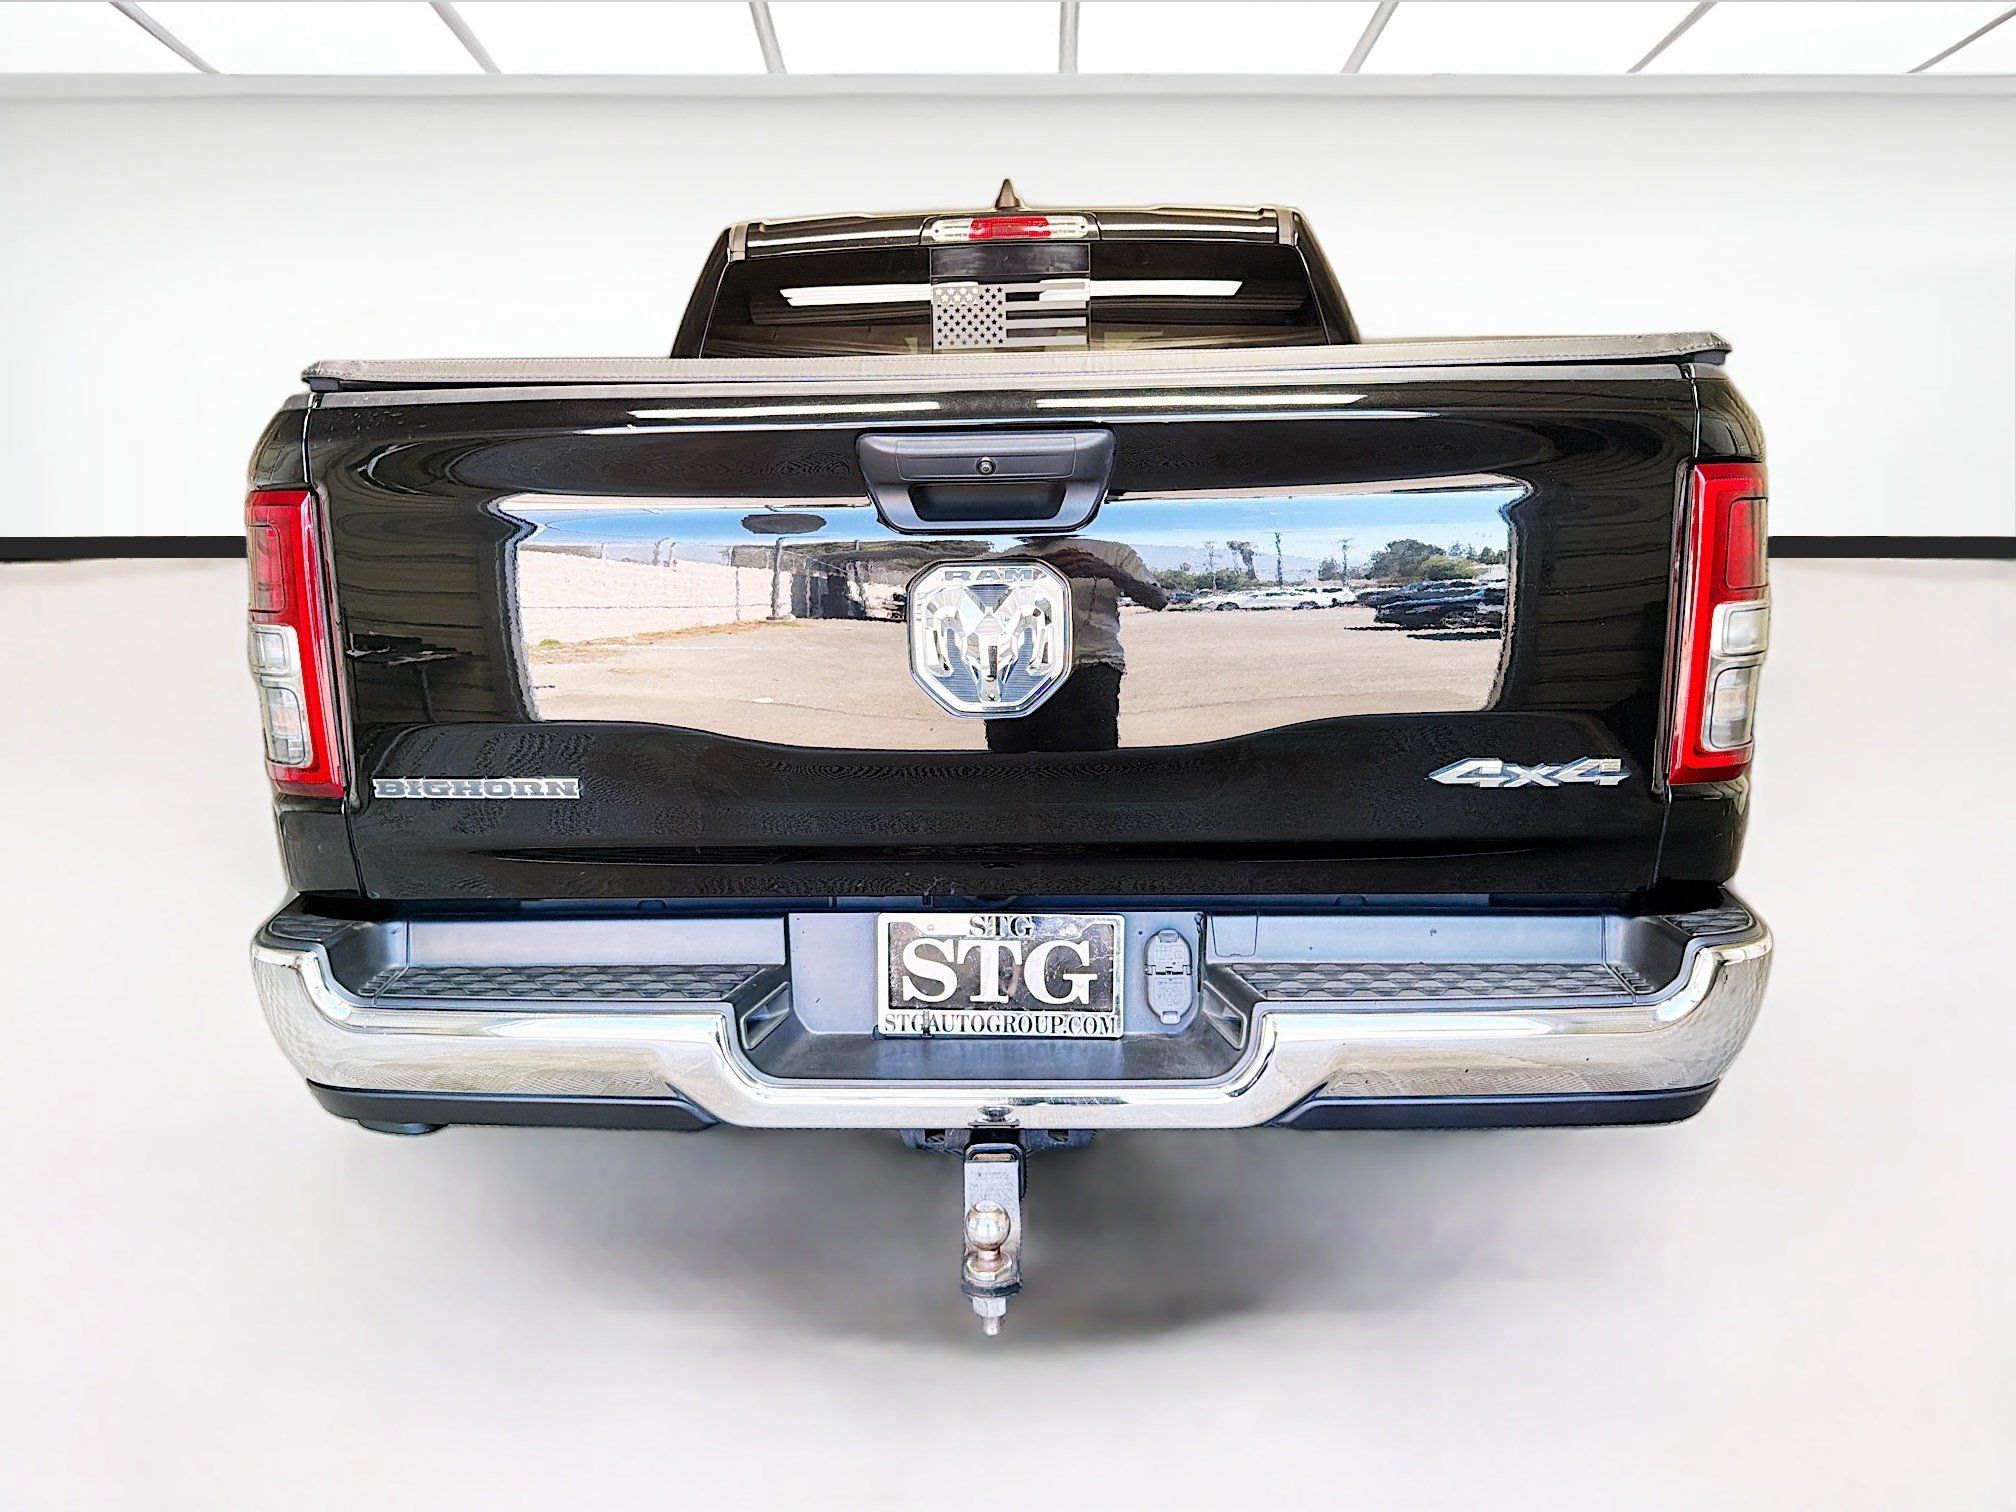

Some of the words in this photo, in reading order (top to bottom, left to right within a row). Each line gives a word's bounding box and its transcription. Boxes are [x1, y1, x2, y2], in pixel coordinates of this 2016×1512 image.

[945, 569, 1034, 581] RAM
[372, 777, 581, 800] BIGHORN
[969, 915, 1033, 937] STG
[902, 938, 1098, 1005] STG
[884, 1013, 1117, 1036] STGAUTOGROUP.COM
